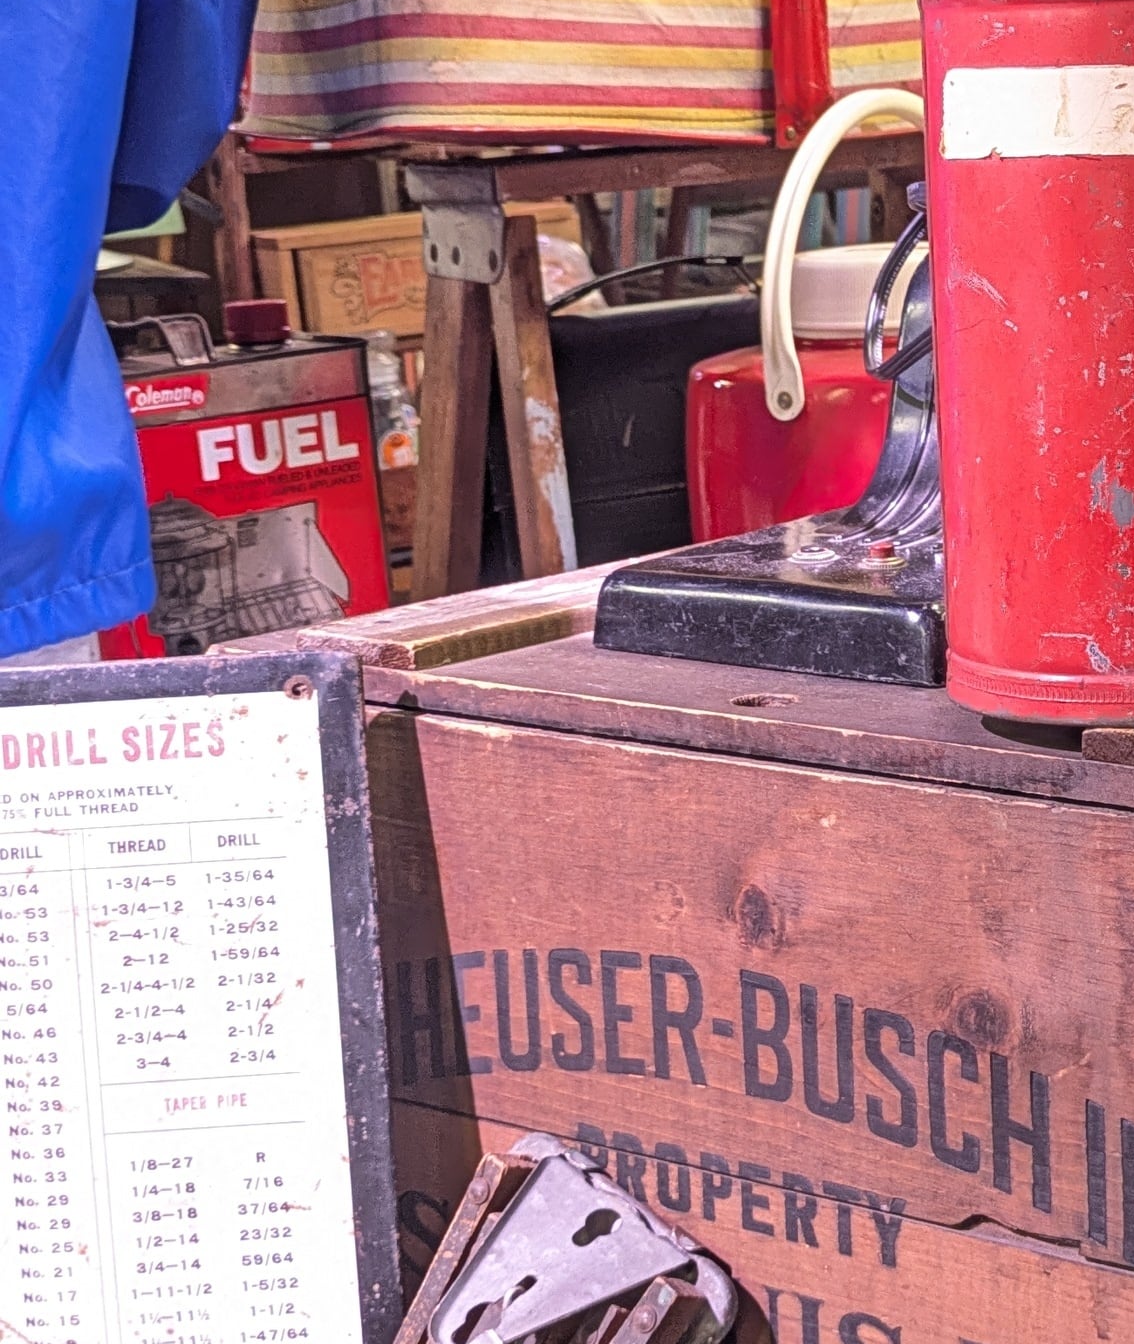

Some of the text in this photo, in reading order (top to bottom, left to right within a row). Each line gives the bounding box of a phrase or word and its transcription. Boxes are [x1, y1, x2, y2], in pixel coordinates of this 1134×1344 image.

[126, 385, 194, 413] Coleman
[197, 410, 360, 482] FUEL
[2, 721, 225, 770] DRILL SIZES
[20, 785, 172, 803] ON APPROXIMATELY
[35, 806, 71, 818] FULL
[80, 803, 138, 814] THREAD
[108, 839, 166, 853] THREAD
[218, 833, 260, 847] DRILL
[0, 846, 42, 860] DRILL
[107, 875, 176, 891] 1-3/4-5
[206, 870, 274, 883] 1-35/64
[102, 900, 183, 916] 1-3/4-12
[208, 895, 276, 909] 1-43/64
[109, 927, 179, 943] 2-4-1/2
[209, 921, 279, 935] 1-25/32
[123, 953, 169, 966] 2-12
[212, 946, 280, 961] 1-59/64
[101, 977, 195, 994] 2-1/4-4-1/2
[218, 972, 276, 986] 2-1/32
[7, 1003, 48, 1016] 5/64
[115, 1004, 185, 1019] 2-1/2-4
[226, 998, 273, 1013] 2-1/4
[117, 1030, 187, 1045] 2-3/4-4
[228, 1023, 274, 1038] 2-1/2
[137, 1056, 171, 1069] 3-4
[230, 1049, 276, 1063] 2-3/4
[218, 1093, 247, 1107] PIPE
[9, 1124, 62, 1136] No. 37
[131, 1157, 192, 1172] 1/8-27
[256, 1152, 265, 1163] R
[244, 1176, 283, 1189] 7/16
[133, 1182, 195, 1198] 1/4-18
[575, 1122, 907, 1268] PROPERTY
[133, 1207, 198, 1223] 3/8-18
[238, 1201, 290, 1215] 37/64
[137, 1233, 199, 1249] 1/2-14
[240, 1227, 292, 1241] 23/32
[19, 1242, 74, 1254] No. 25
[242, 1252, 293, 1266] 59/64
[137, 1259, 201, 1274] 3/4-14
[132, 1283, 212, 1299] 1-11-1/2
[243, 1277, 298, 1291] 1-5/32
[251, 1303, 295, 1316] 1-1/2
[26, 1315, 80, 1327] No. 15
[241, 1328, 308, 1342] 1-47/64
